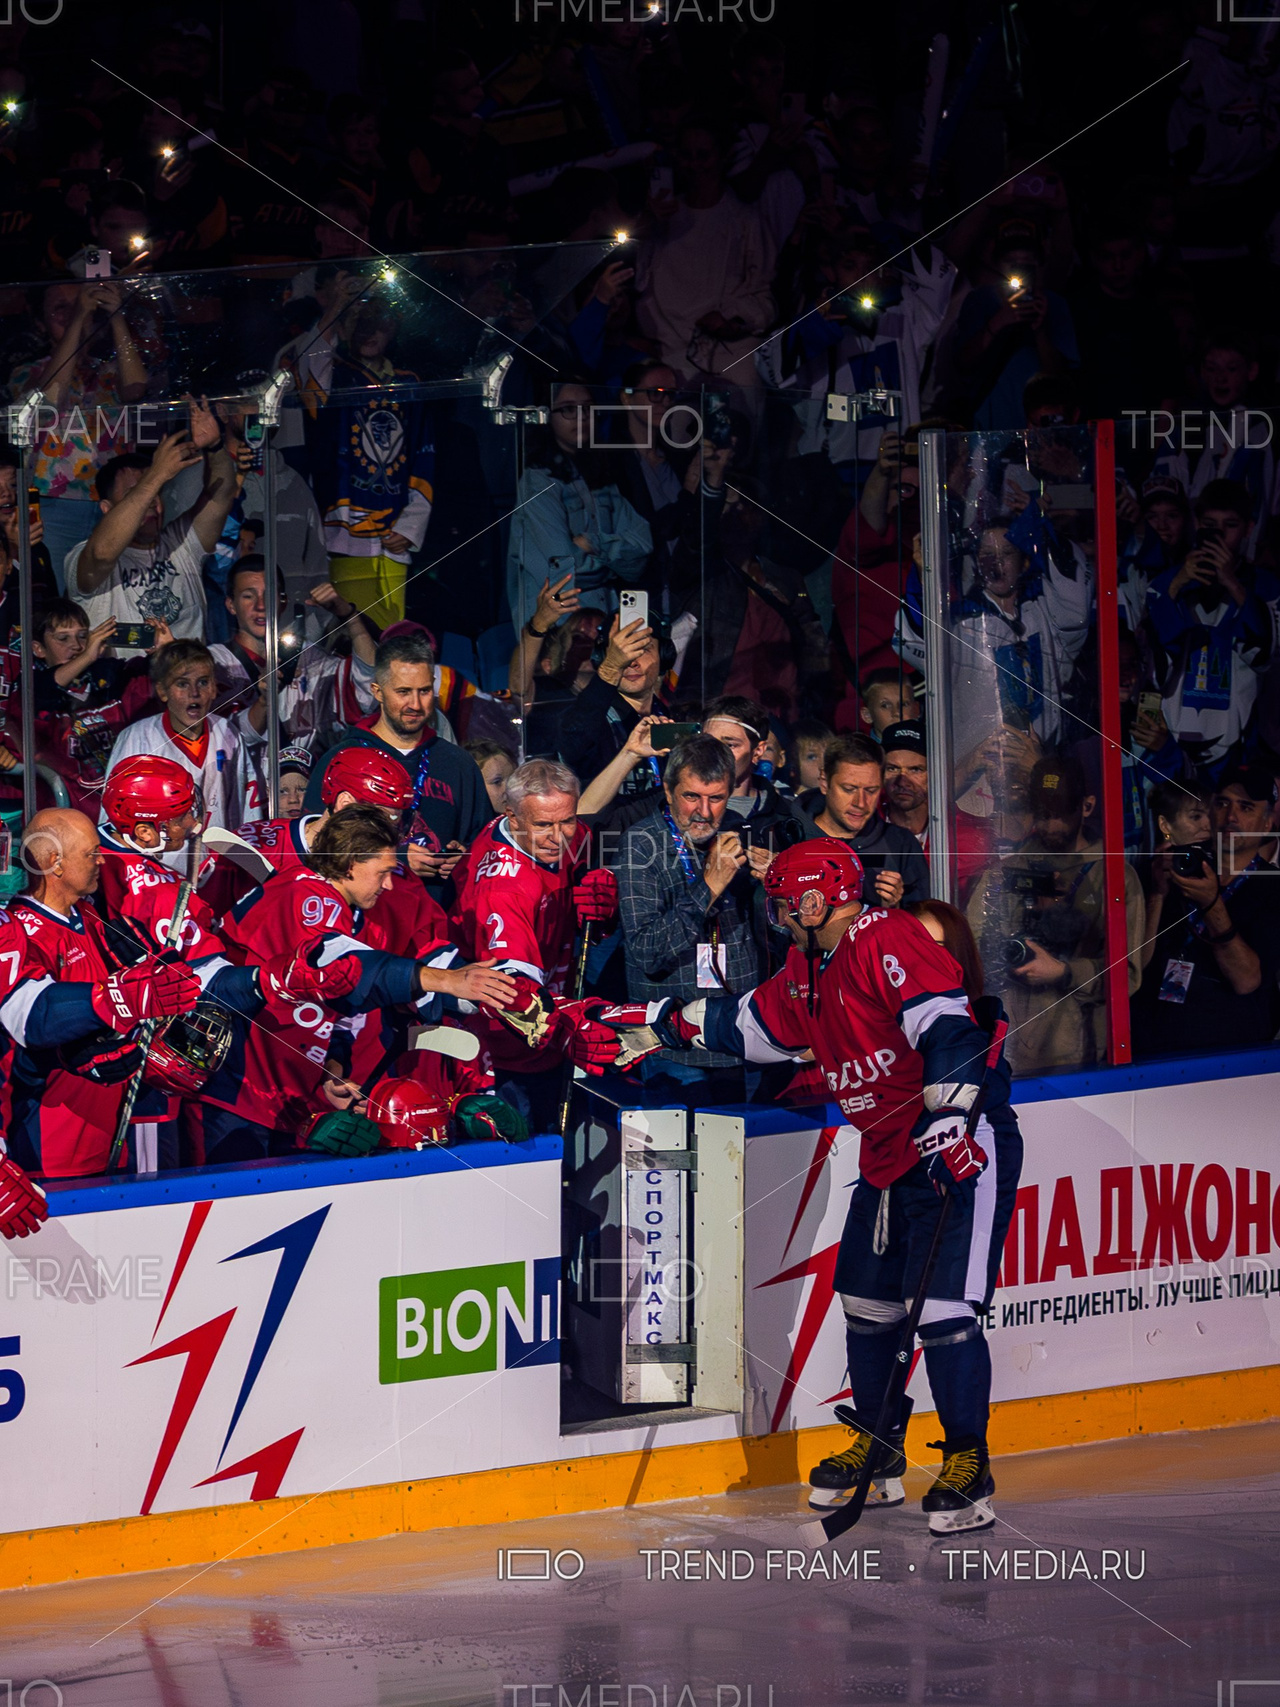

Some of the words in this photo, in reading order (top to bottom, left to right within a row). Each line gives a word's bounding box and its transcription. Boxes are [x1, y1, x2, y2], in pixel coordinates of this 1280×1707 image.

[475, 861, 522, 883] FON
[797, 873, 821, 883] CCM
[301, 896, 343, 928] 97
[847, 909, 889, 943] FON
[486, 912, 508, 951] 2
[882, 953, 907, 989] 8
[839, 1092, 878, 1116] 895
[644, 1170, 664, 1345] СПОРТМАКС
[1002, 1287, 1149, 1329] ИНГРЕДИЕНТЫ.
[1156, 1276, 1222, 1308] ЛУЧШЕ
